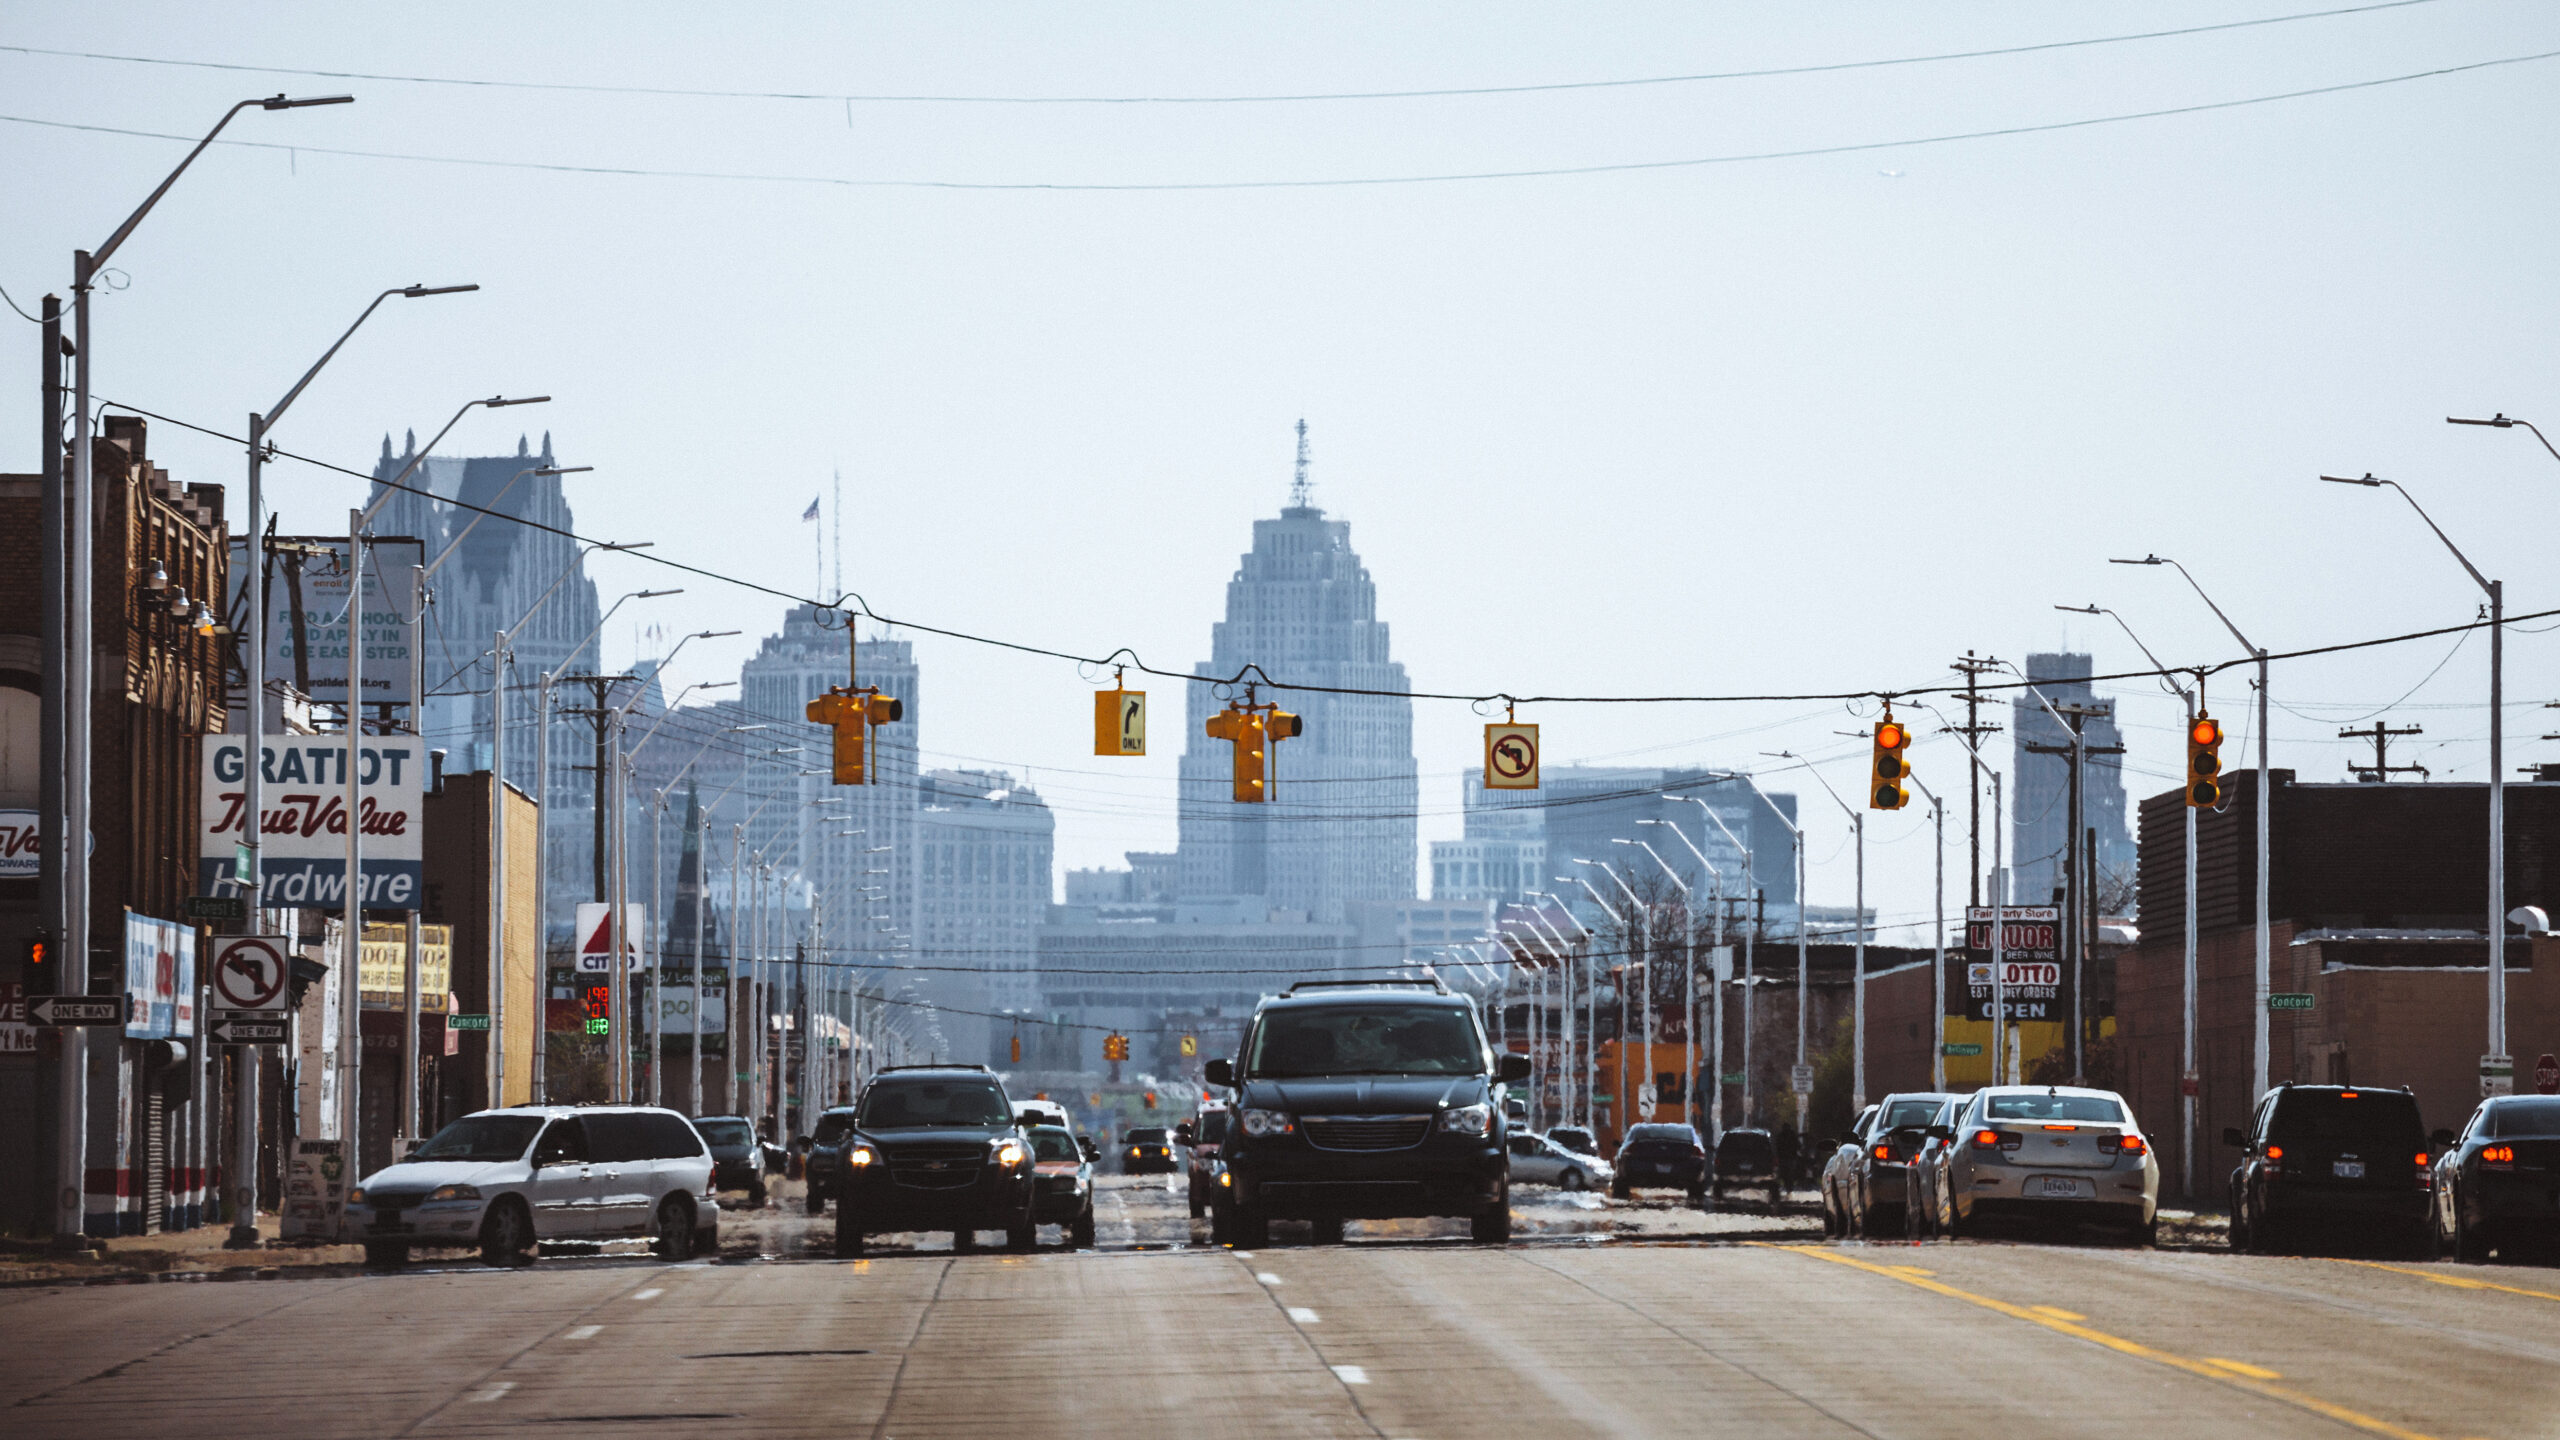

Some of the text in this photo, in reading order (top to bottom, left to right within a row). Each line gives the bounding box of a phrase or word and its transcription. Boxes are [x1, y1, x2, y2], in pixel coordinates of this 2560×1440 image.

[279, 610, 318, 623] FD
[338, 611, 407, 625] SHOOL
[325, 628, 378, 642] APY
[382, 629, 399, 642] IN
[279, 645, 315, 658] OE
[319, 645, 360, 659] EAS
[1123, 737, 1142, 750] ONLY
[213, 745, 410, 786] GRATIOT
[209, 861, 413, 903] Hrdware
[2000, 909, 2022, 920] arty
[2025, 909, 2054, 918] Store
[1971, 925, 2055, 952] LIQUOR
[2006, 950, 2055, 960] BEER WINE
[582, 955, 636, 970] CITO
[2001, 964, 2057, 984] OTTO
[2271, 996, 2312, 1007] Concord
[52, 1005, 112, 1017] ONE WAY
[1982, 1002, 2046, 1018] OPEN
[450, 1016, 488, 1028] Concord
[1665, 1021, 1691, 1034] KF
[230, 1026, 280, 1037] ONE WAY
[2537, 1068, 2559, 1085] STOP
